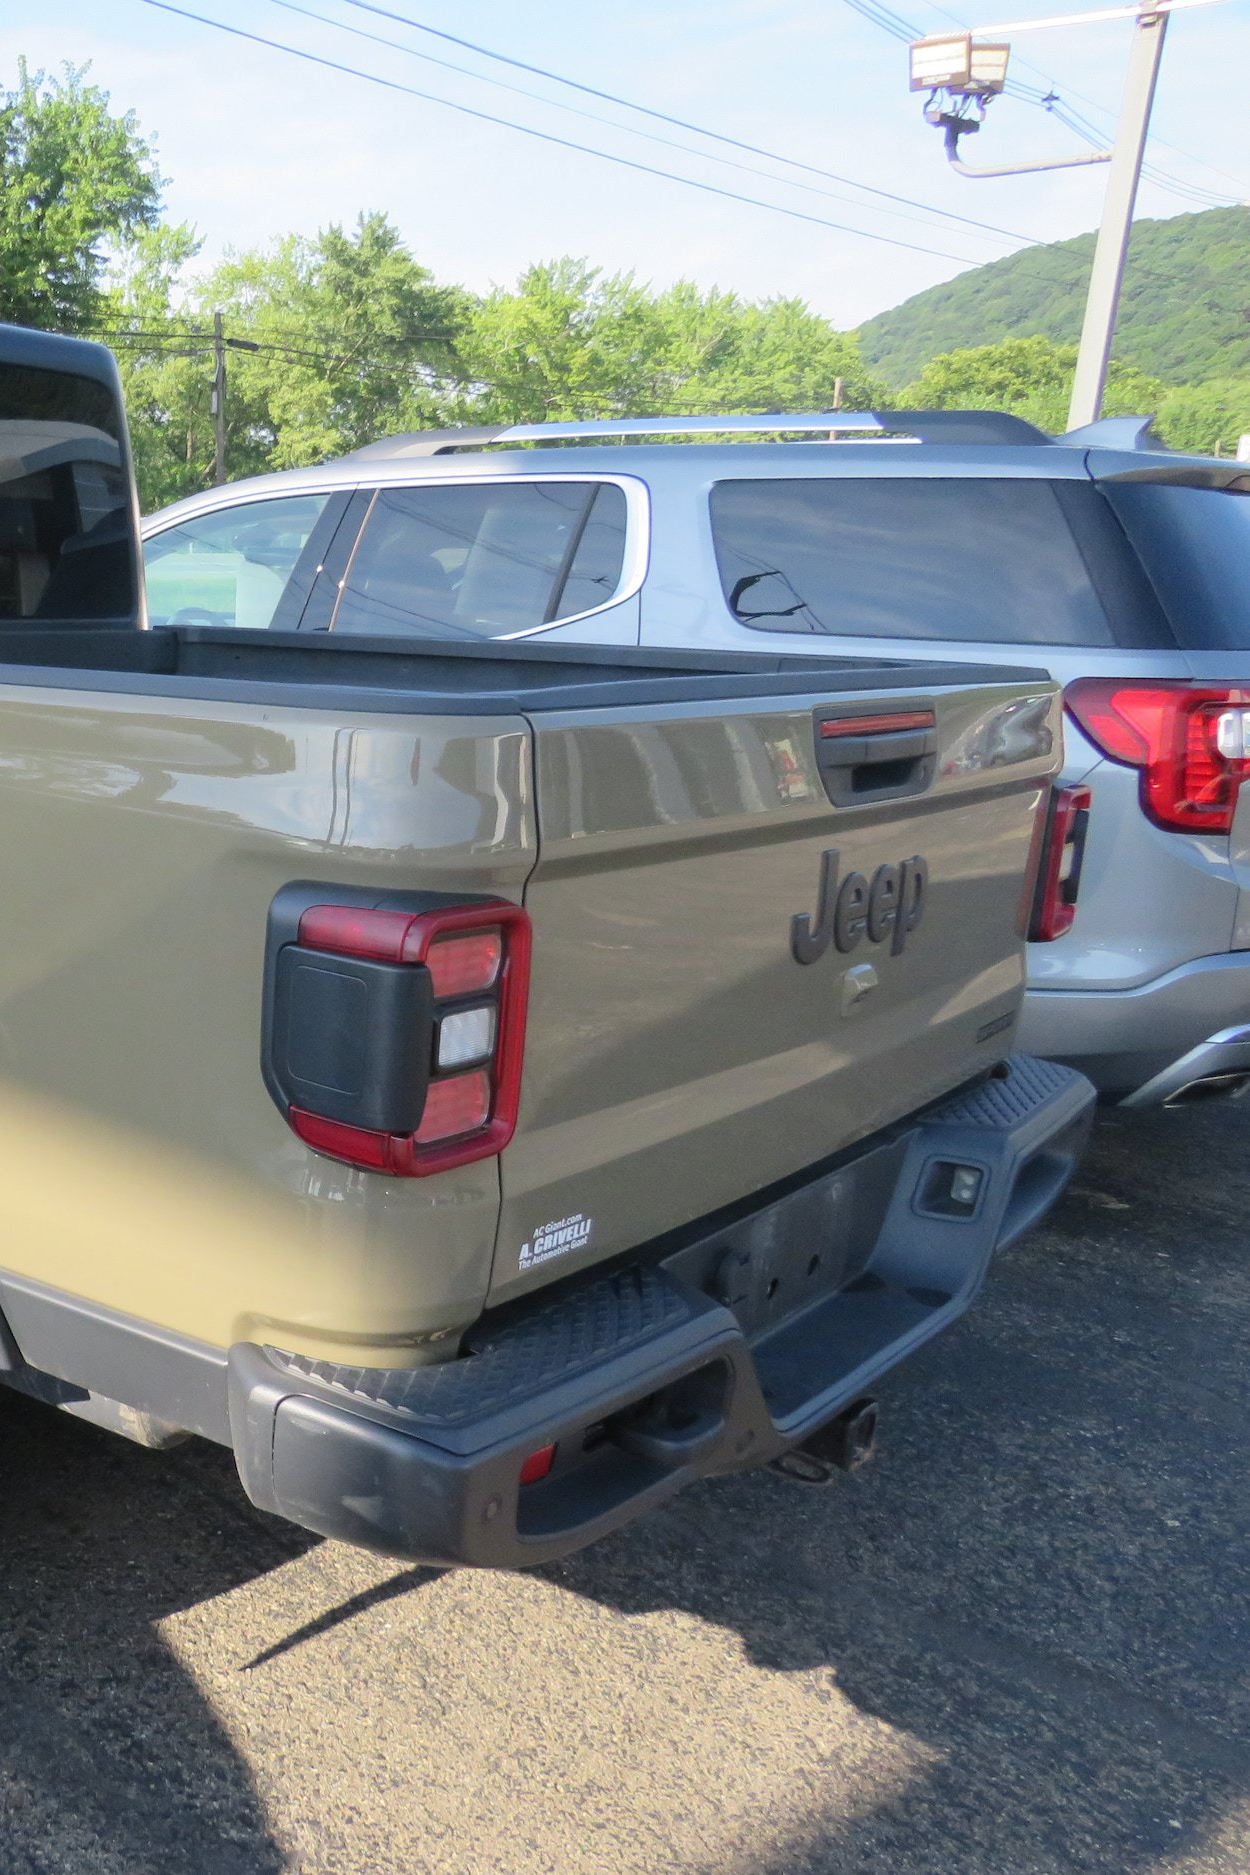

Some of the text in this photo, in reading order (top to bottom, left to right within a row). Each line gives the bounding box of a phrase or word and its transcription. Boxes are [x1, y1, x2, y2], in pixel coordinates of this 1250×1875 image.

[790, 848, 928, 966] Jeep
[532, 1244, 570, 1266] Automotive
[570, 1235, 588, 1249] Giant
[534, 1218, 592, 1254] CRIVELLI
